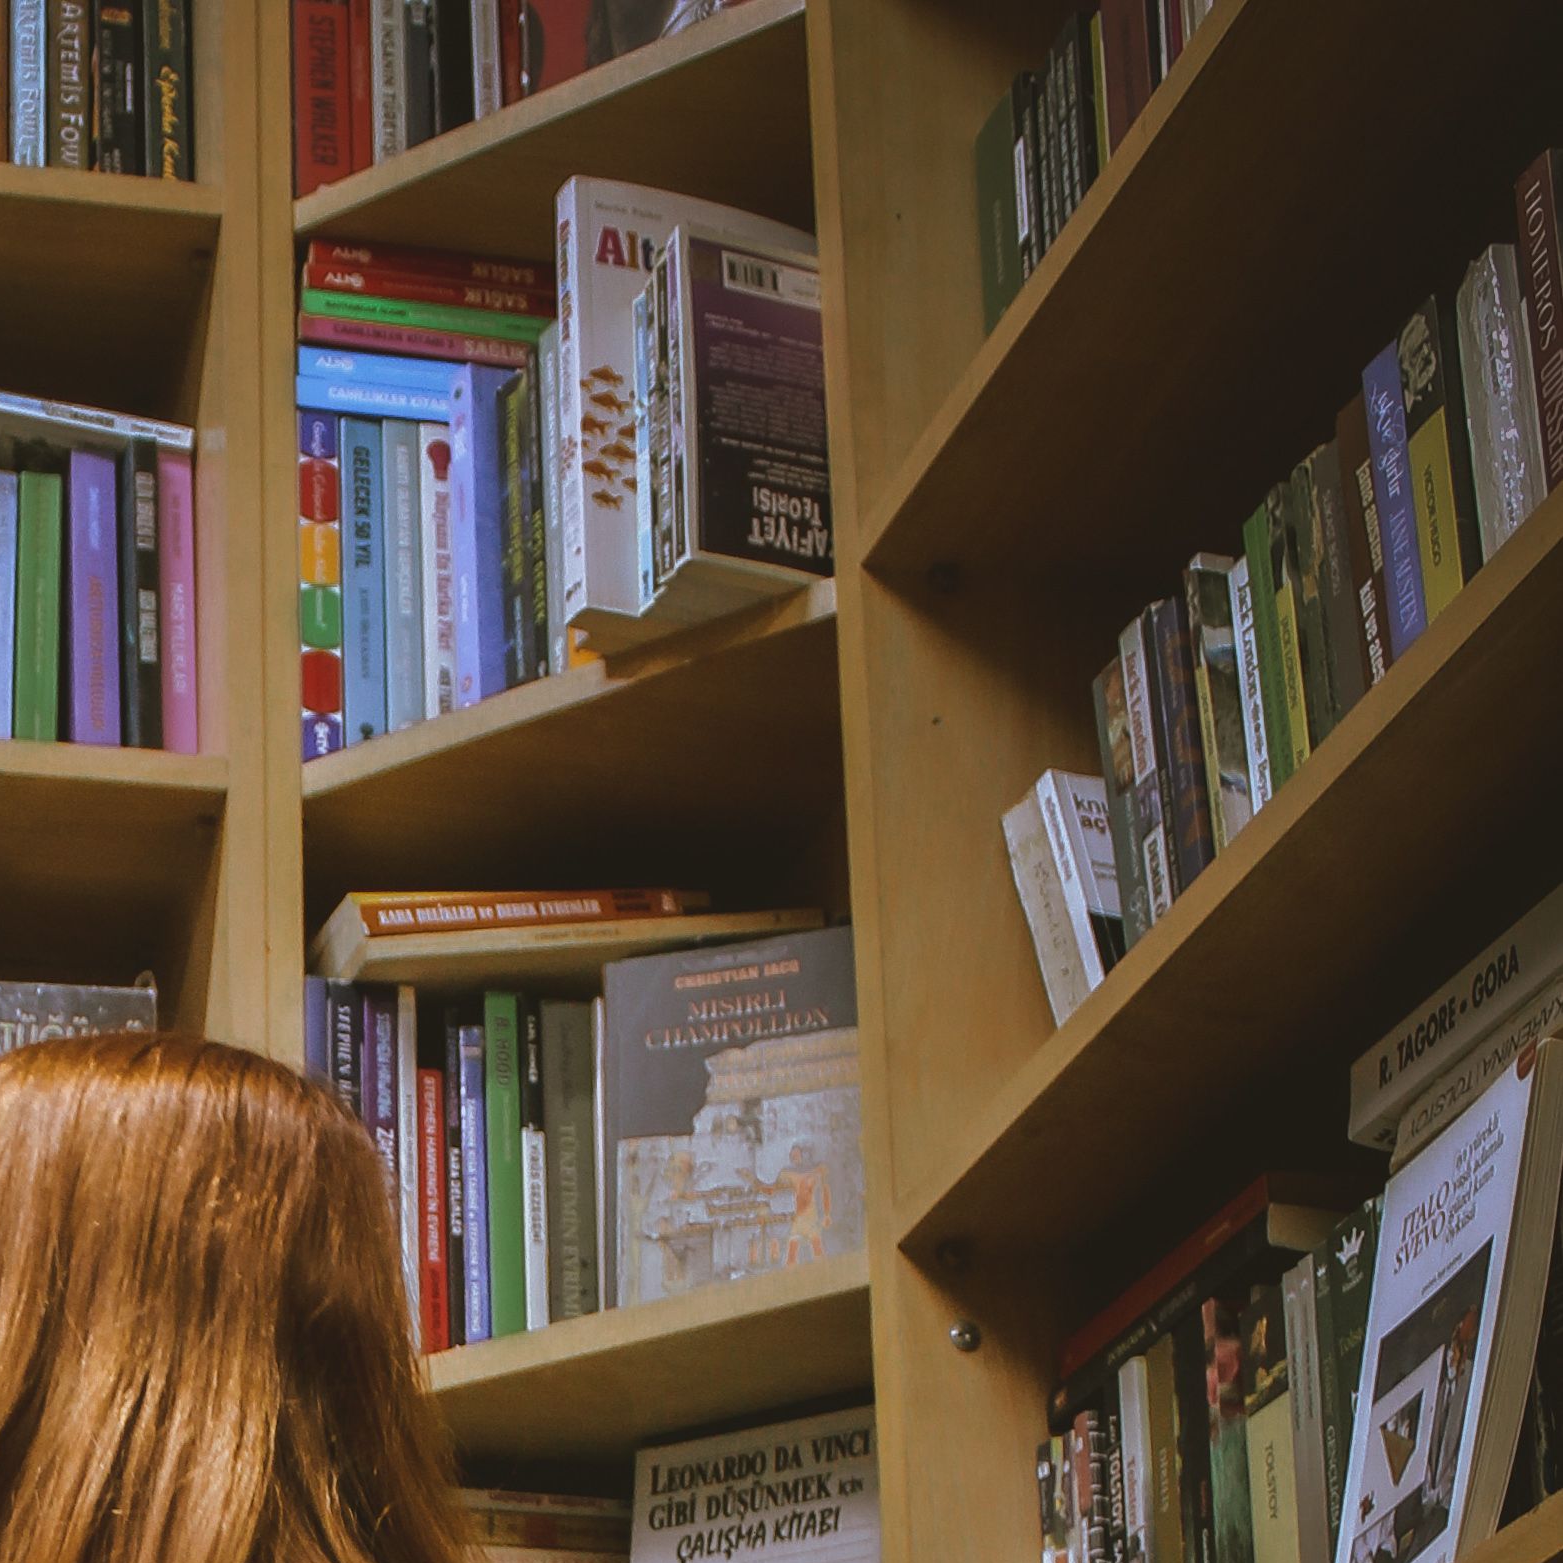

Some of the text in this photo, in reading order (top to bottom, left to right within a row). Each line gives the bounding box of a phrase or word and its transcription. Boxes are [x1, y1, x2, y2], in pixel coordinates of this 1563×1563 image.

[376, 903, 477, 926] KARA DELİKLER
[645, 1007, 831, 1050] CHAMPOLLION
[1378, 945, 1520, 1089] R. TAGORE GORA
[1392, 1207, 1448, 1277] SVEVO
[1401, 1181, 1451, 1243] ITALO
[649, 1428, 872, 1497] LEONARDO DA VINCI
[1265, 1442, 1279, 1520] TOLSTOY
[648, 1470, 833, 1532] GİBİ DÜŞÜNMEK
[773, 1505, 842, 1542] KİTABI
